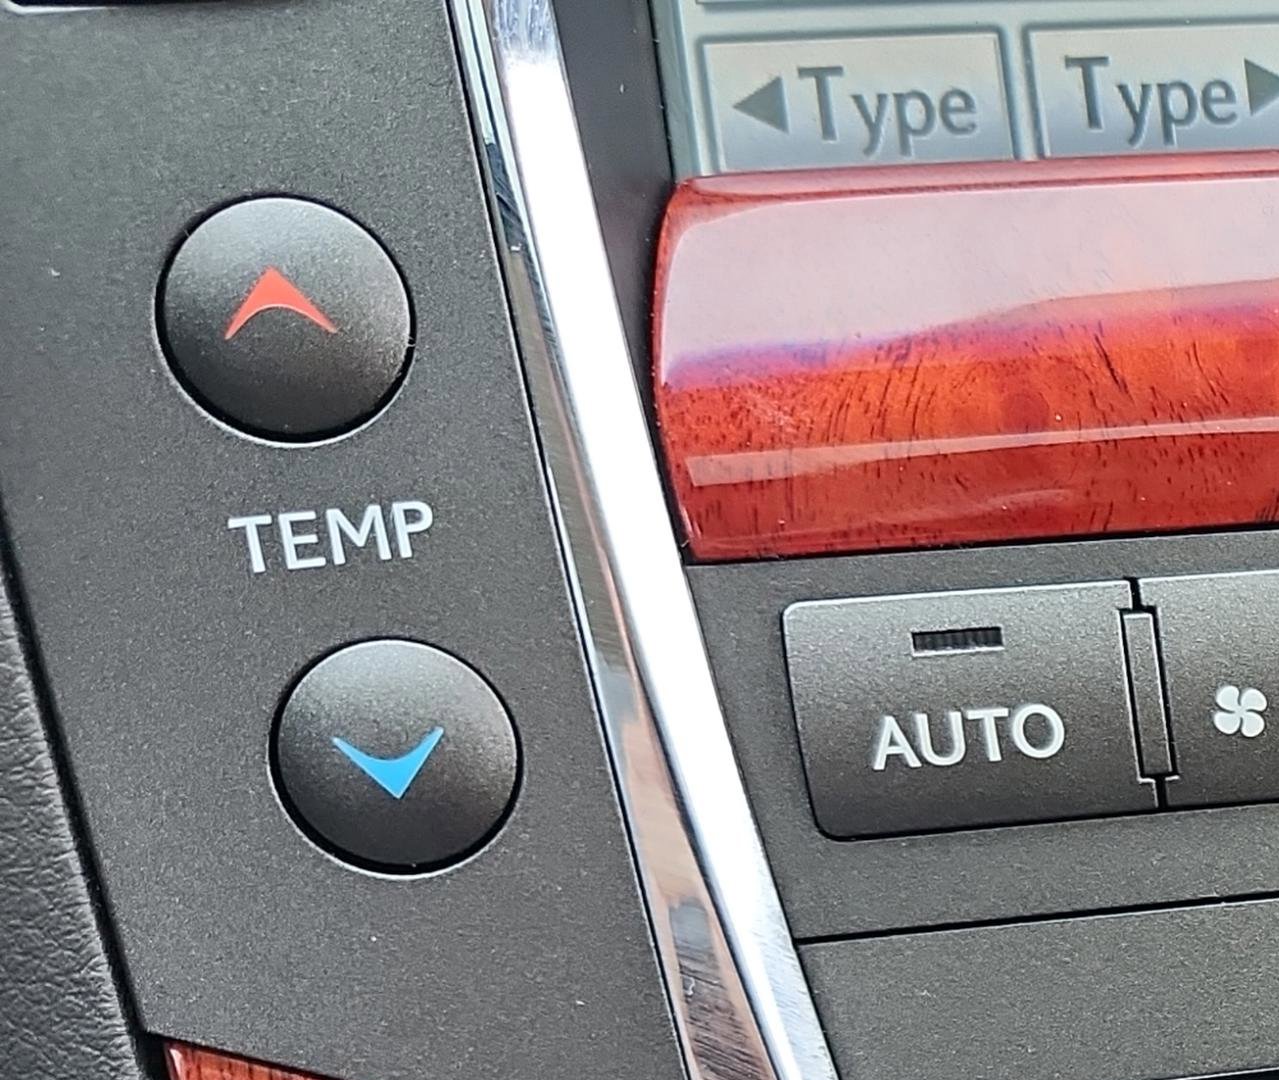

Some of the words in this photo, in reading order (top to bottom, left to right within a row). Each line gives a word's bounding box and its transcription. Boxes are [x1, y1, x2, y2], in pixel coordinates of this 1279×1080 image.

[796, 65, 977, 158] Type
[1063, 54, 1238, 148] Type
[228, 500, 434, 574] TEMP
[873, 703, 1066, 772] AUTO
